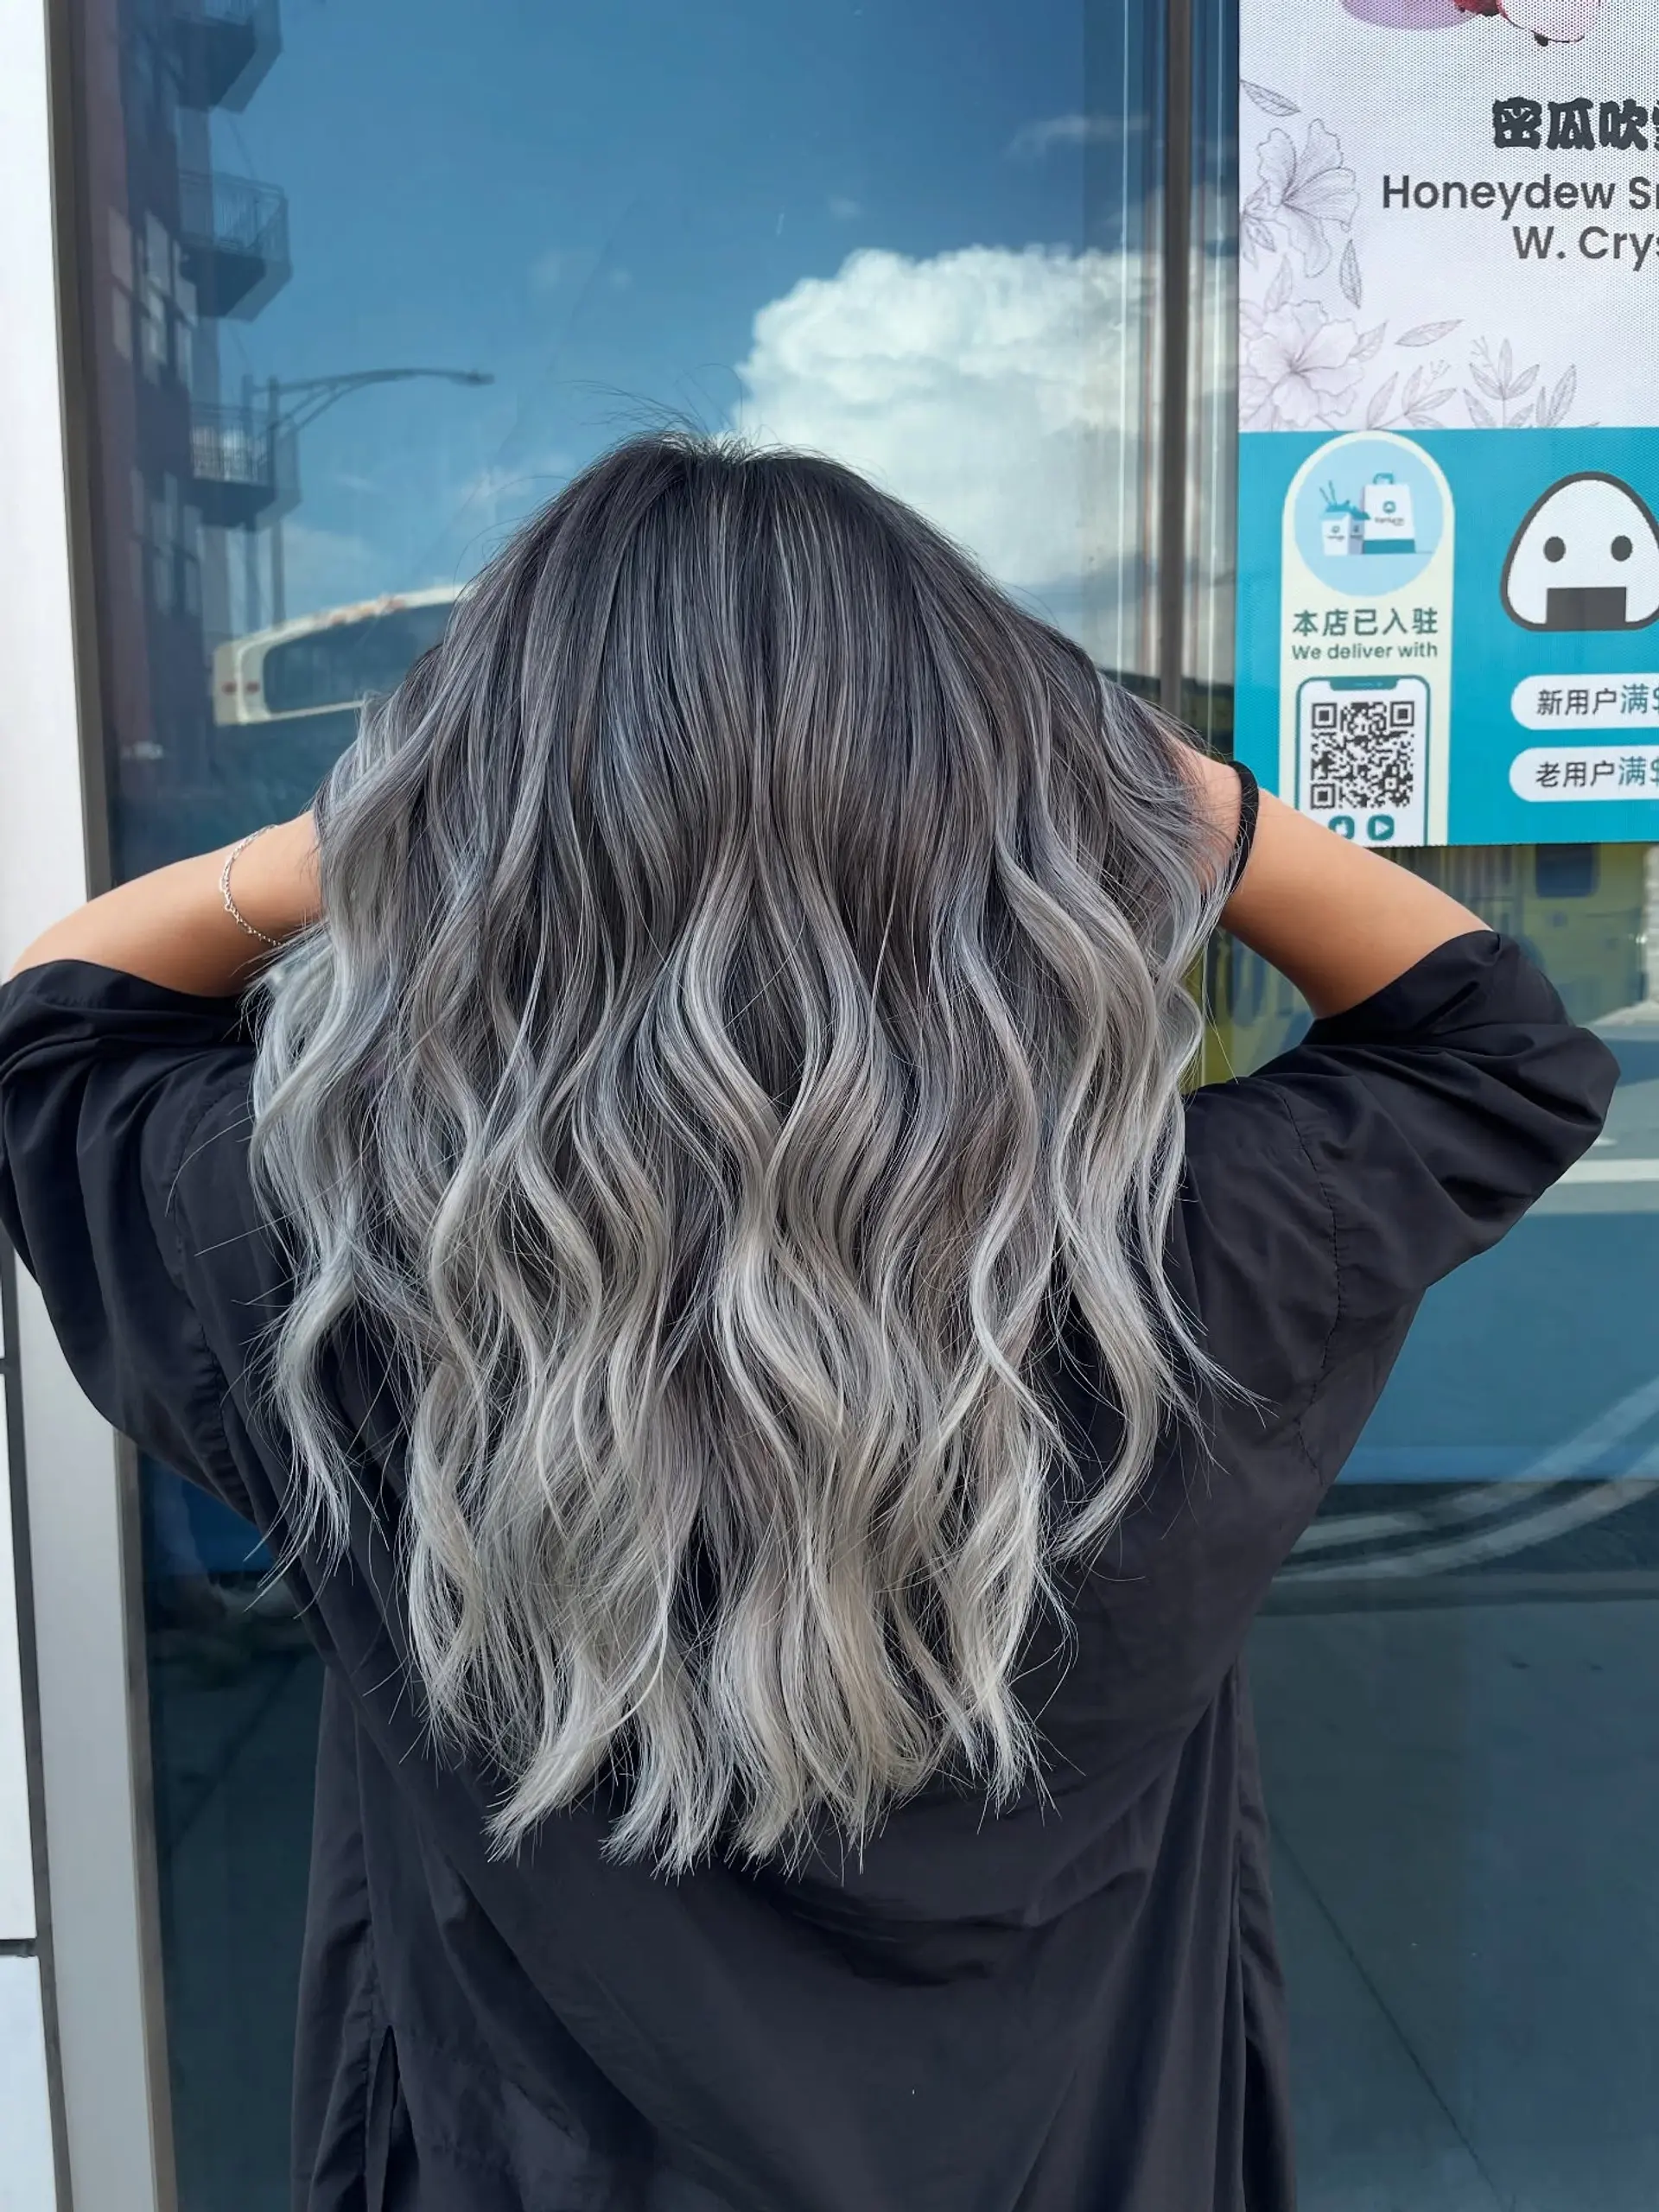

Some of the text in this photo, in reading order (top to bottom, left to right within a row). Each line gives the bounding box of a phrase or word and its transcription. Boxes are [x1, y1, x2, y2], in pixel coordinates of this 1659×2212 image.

[1492, 97, 1659, 150] 密瓜吹
[1383, 174, 1659, 221] Honeydew S
[1512, 226, 1659, 271] W. Cry
[1293, 607, 1438, 637] 本店已入驻
[1292, 641, 1438, 659] We deliver with
